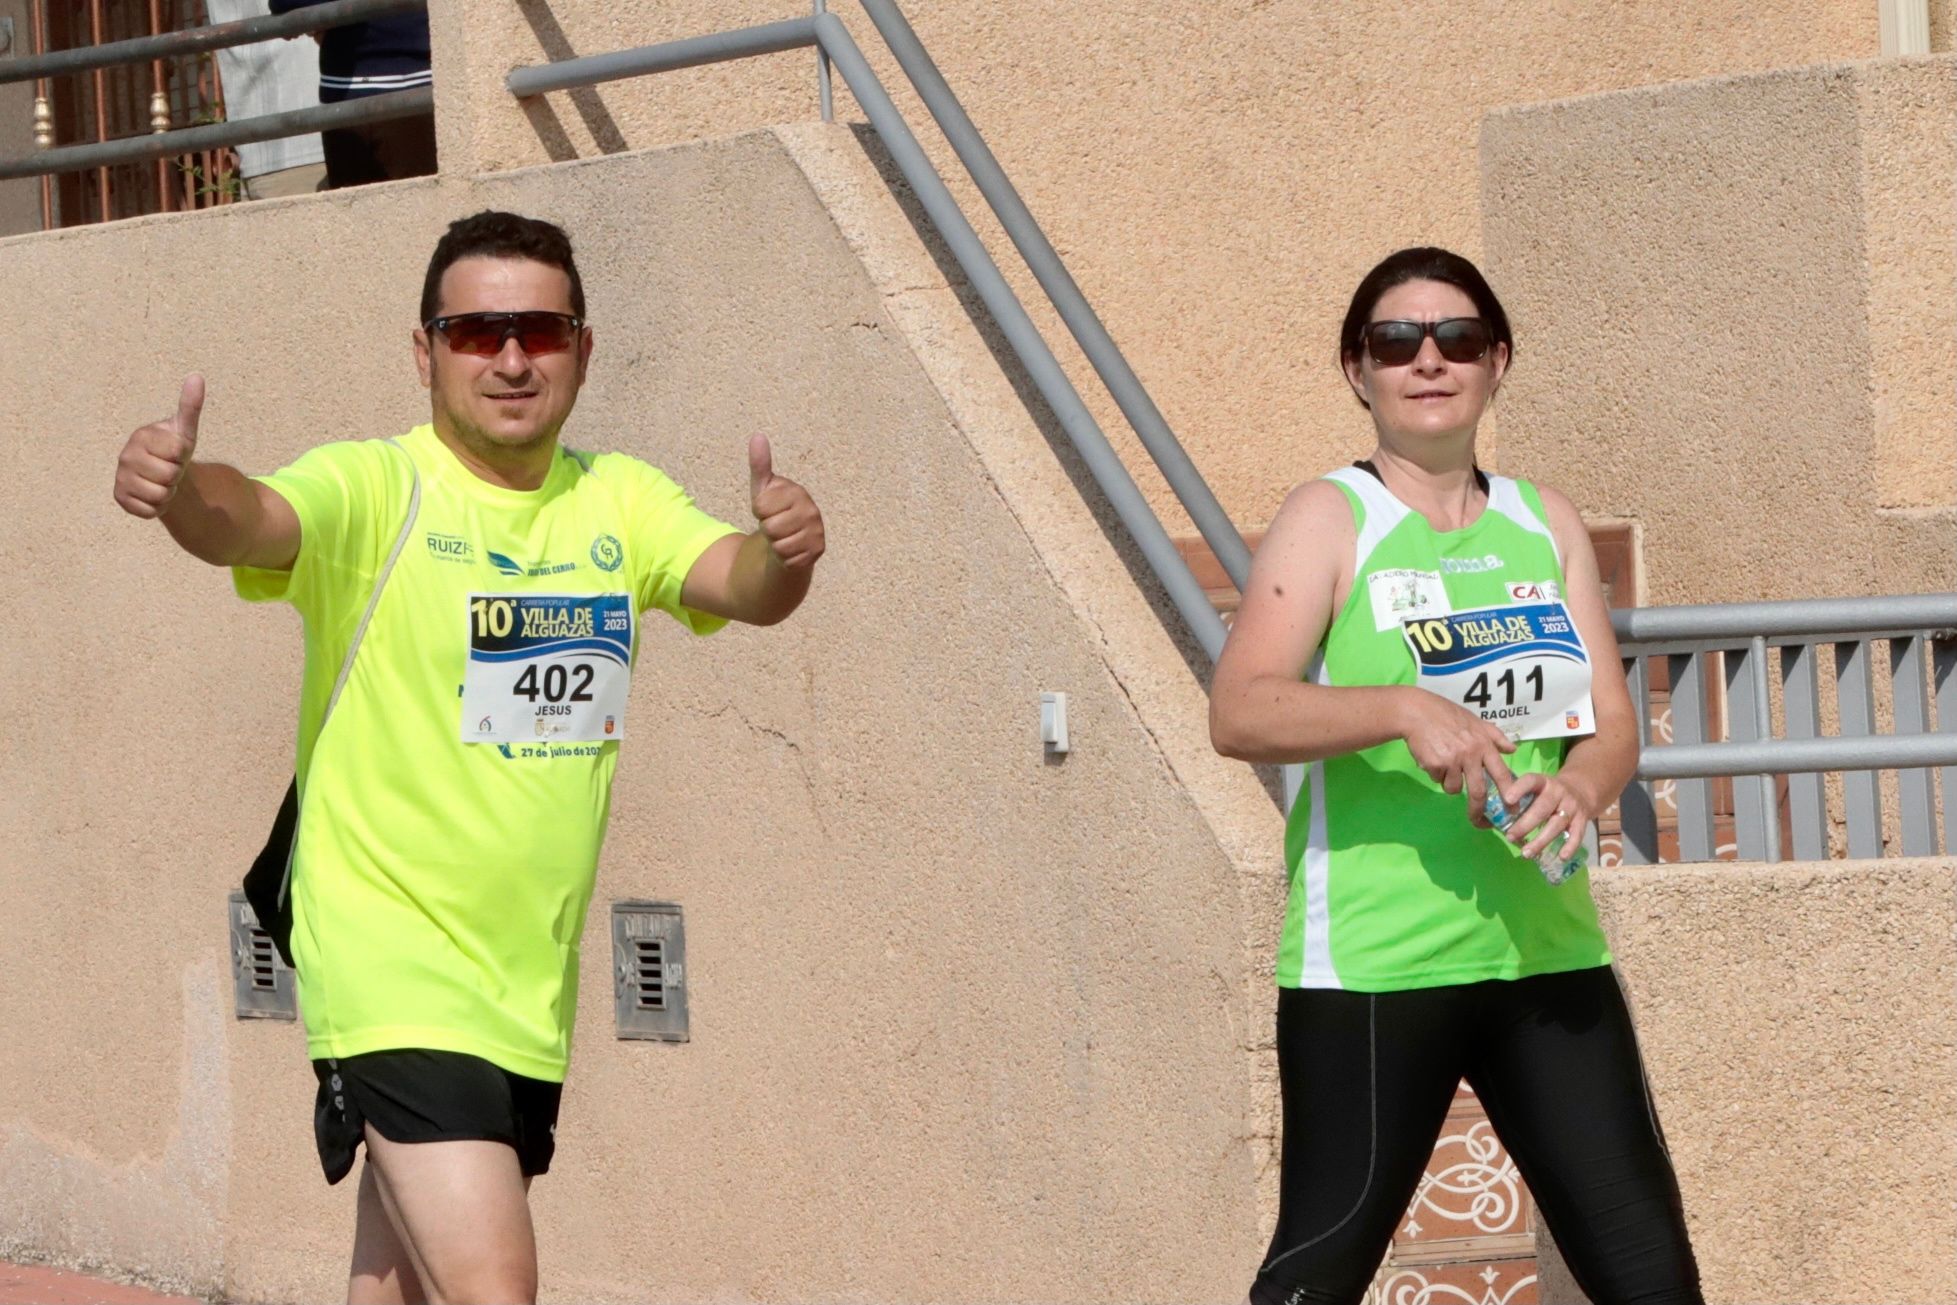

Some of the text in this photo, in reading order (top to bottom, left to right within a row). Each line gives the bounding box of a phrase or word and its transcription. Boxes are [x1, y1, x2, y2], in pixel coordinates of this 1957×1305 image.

[521, 608, 593, 624] VILLA DE
[521, 623, 594, 637] ALGUAZAS
[604, 619, 627, 631] 2023
[1454, 616, 1530, 638] VILLA DE
[1542, 622, 1569, 634] 2023
[1463, 629, 1535, 648] ALGUAZAS
[513, 663, 594, 703] 402
[1463, 664, 1543, 708] 411
[535, 705, 572, 716] JESUS
[1480, 706, 1530, 720] RAQUEL
[521, 748, 533, 757] 27
[536, 748, 547, 757] de
[550, 746, 572, 758] julio
[573, 746, 585, 756] de
